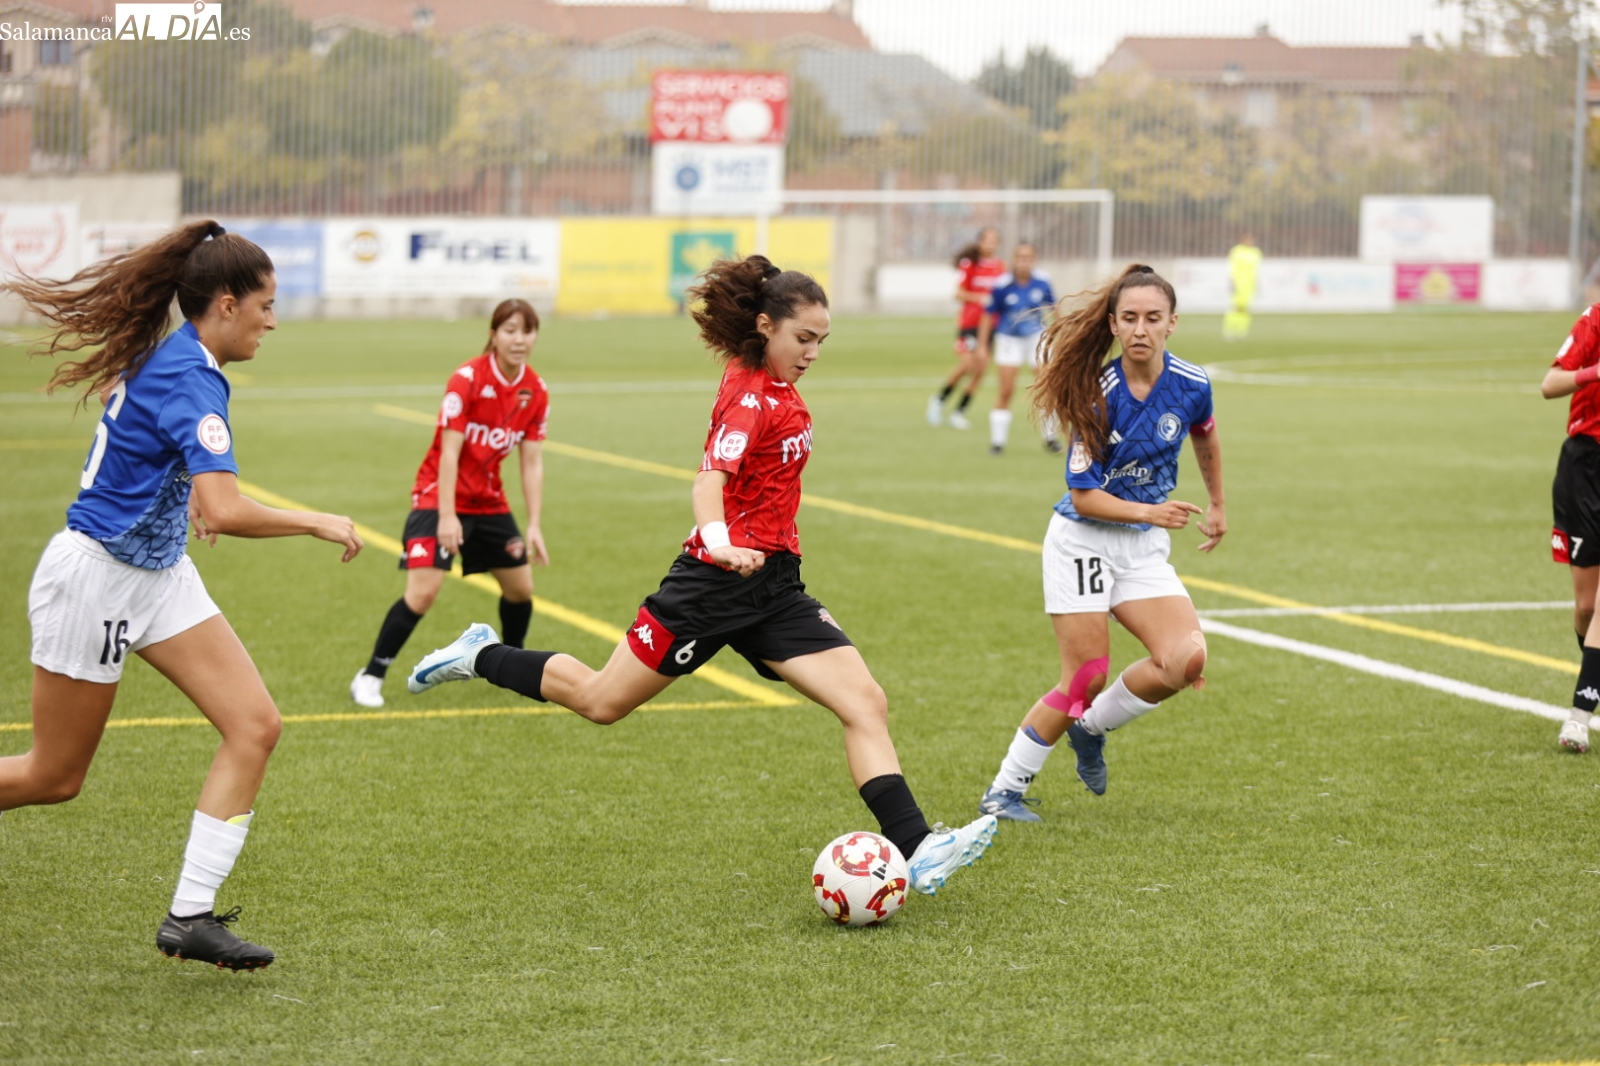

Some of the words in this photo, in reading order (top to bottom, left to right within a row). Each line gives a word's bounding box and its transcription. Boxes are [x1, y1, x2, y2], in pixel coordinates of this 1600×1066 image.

[409, 230, 542, 264] FIDEL
[1570, 535, 1584, 560] 7
[1074, 556, 1104, 596] 12
[99, 619, 131, 666] 16
[674, 639, 697, 665] 6
